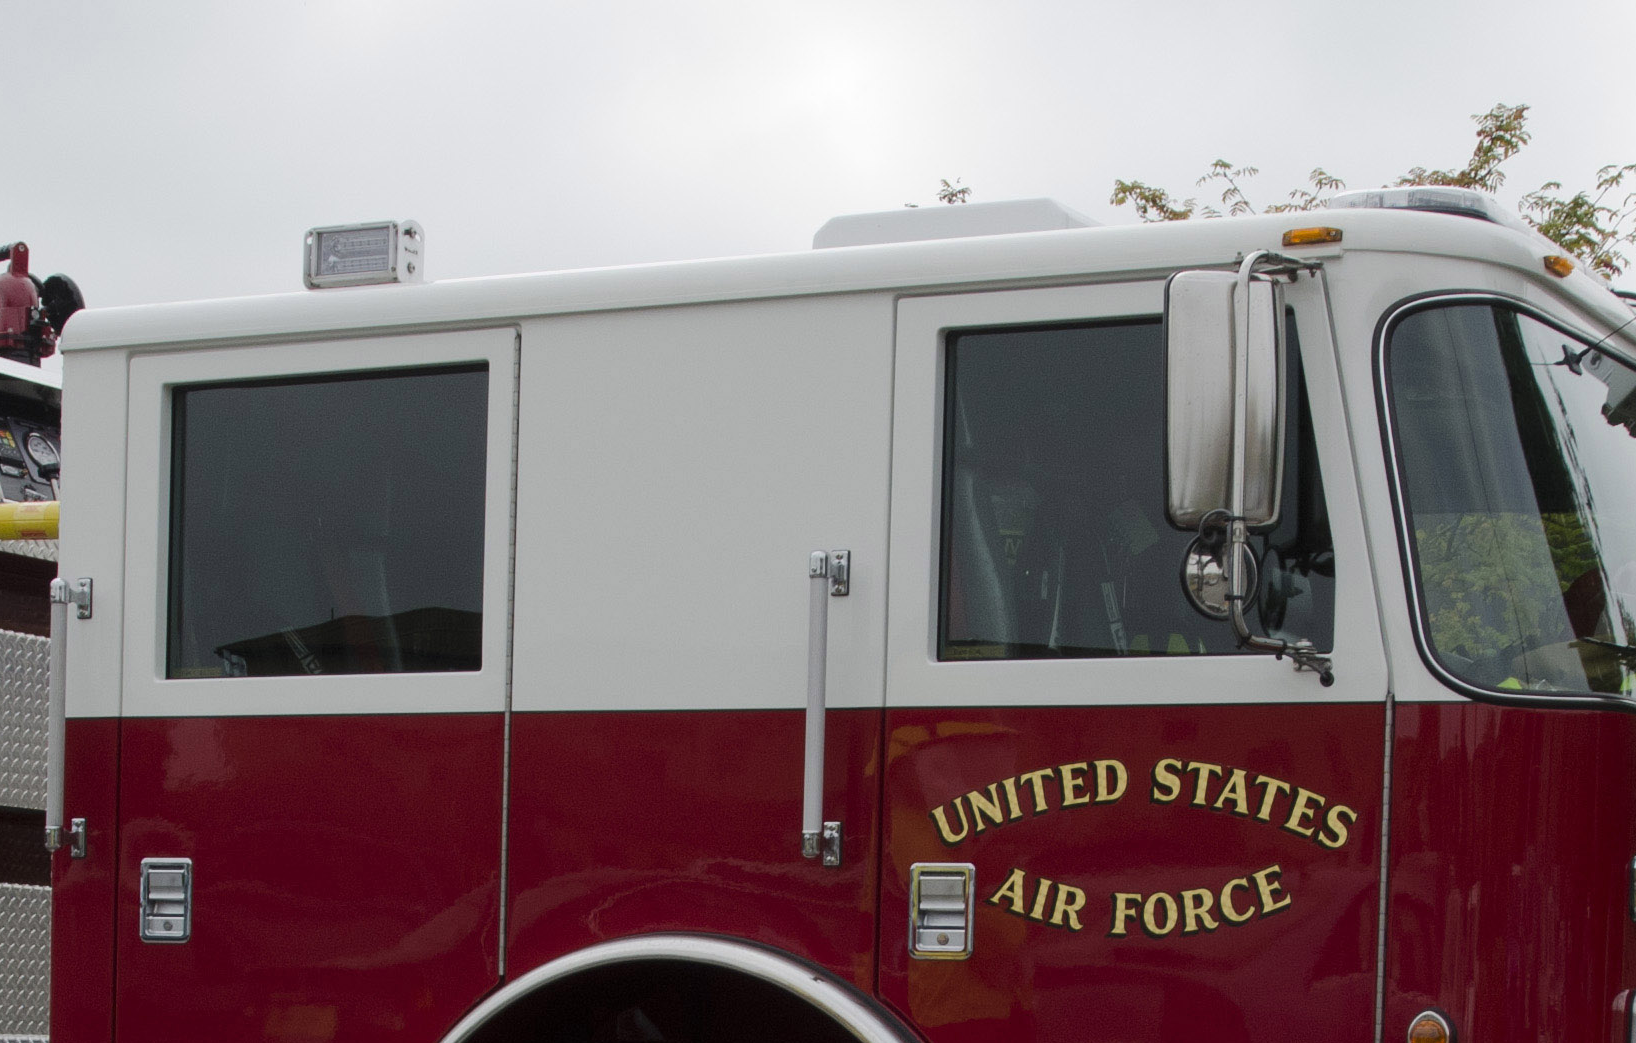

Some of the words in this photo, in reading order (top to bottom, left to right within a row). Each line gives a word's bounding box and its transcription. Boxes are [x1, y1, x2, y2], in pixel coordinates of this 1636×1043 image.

[929, 759, 1129, 847] UNITED
[1151, 758, 1359, 850] STATES
[988, 867, 1087, 932] AIR
[1107, 864, 1292, 938] FORCE
